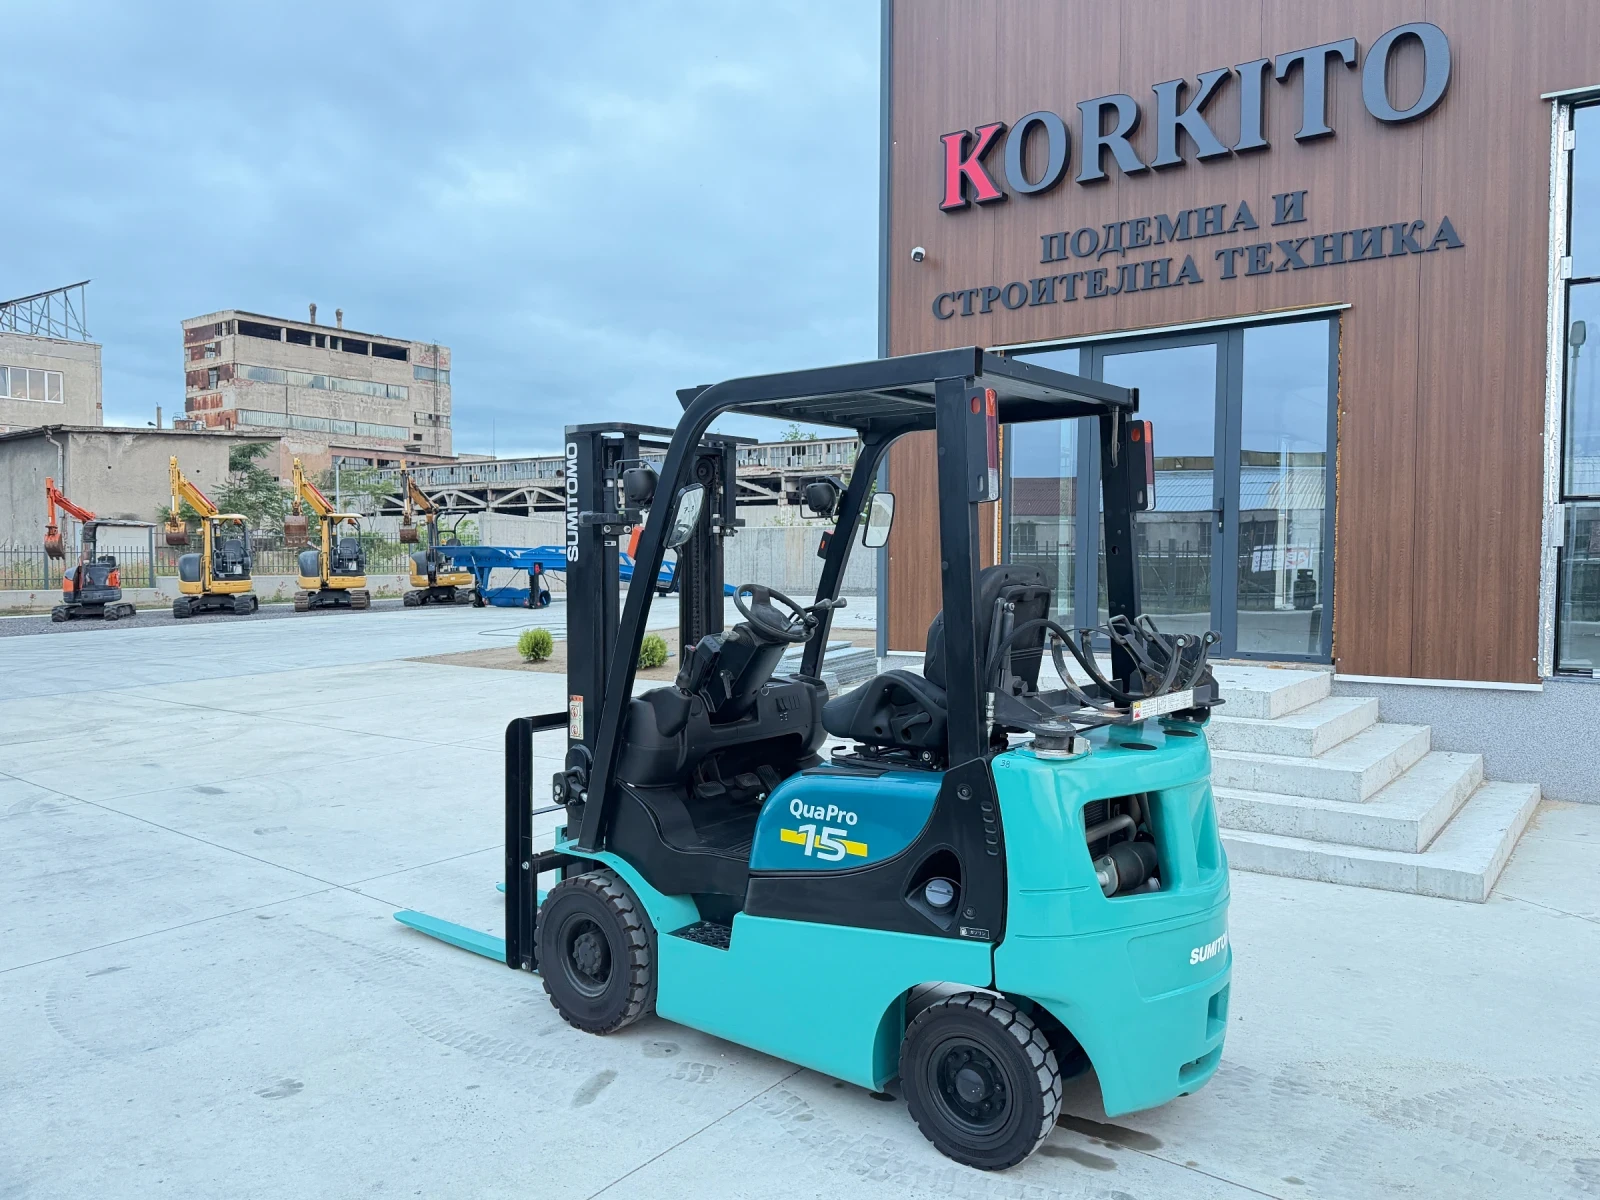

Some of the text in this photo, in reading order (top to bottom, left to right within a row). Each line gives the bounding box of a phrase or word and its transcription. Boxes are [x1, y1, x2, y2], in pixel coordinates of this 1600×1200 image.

[939, 22, 1452, 213] KORKITO
[1040, 190, 1308, 261] ПОДЕМНА И
[932, 215, 1465, 320] СТРОИТЕЛНА ТЕХНИКА
[566, 442, 579, 562] SUMITOMO
[789, 798, 858, 826] QuaPro
[798, 824, 848, 862] 15
[1190, 930, 1228, 965] SUMITO
